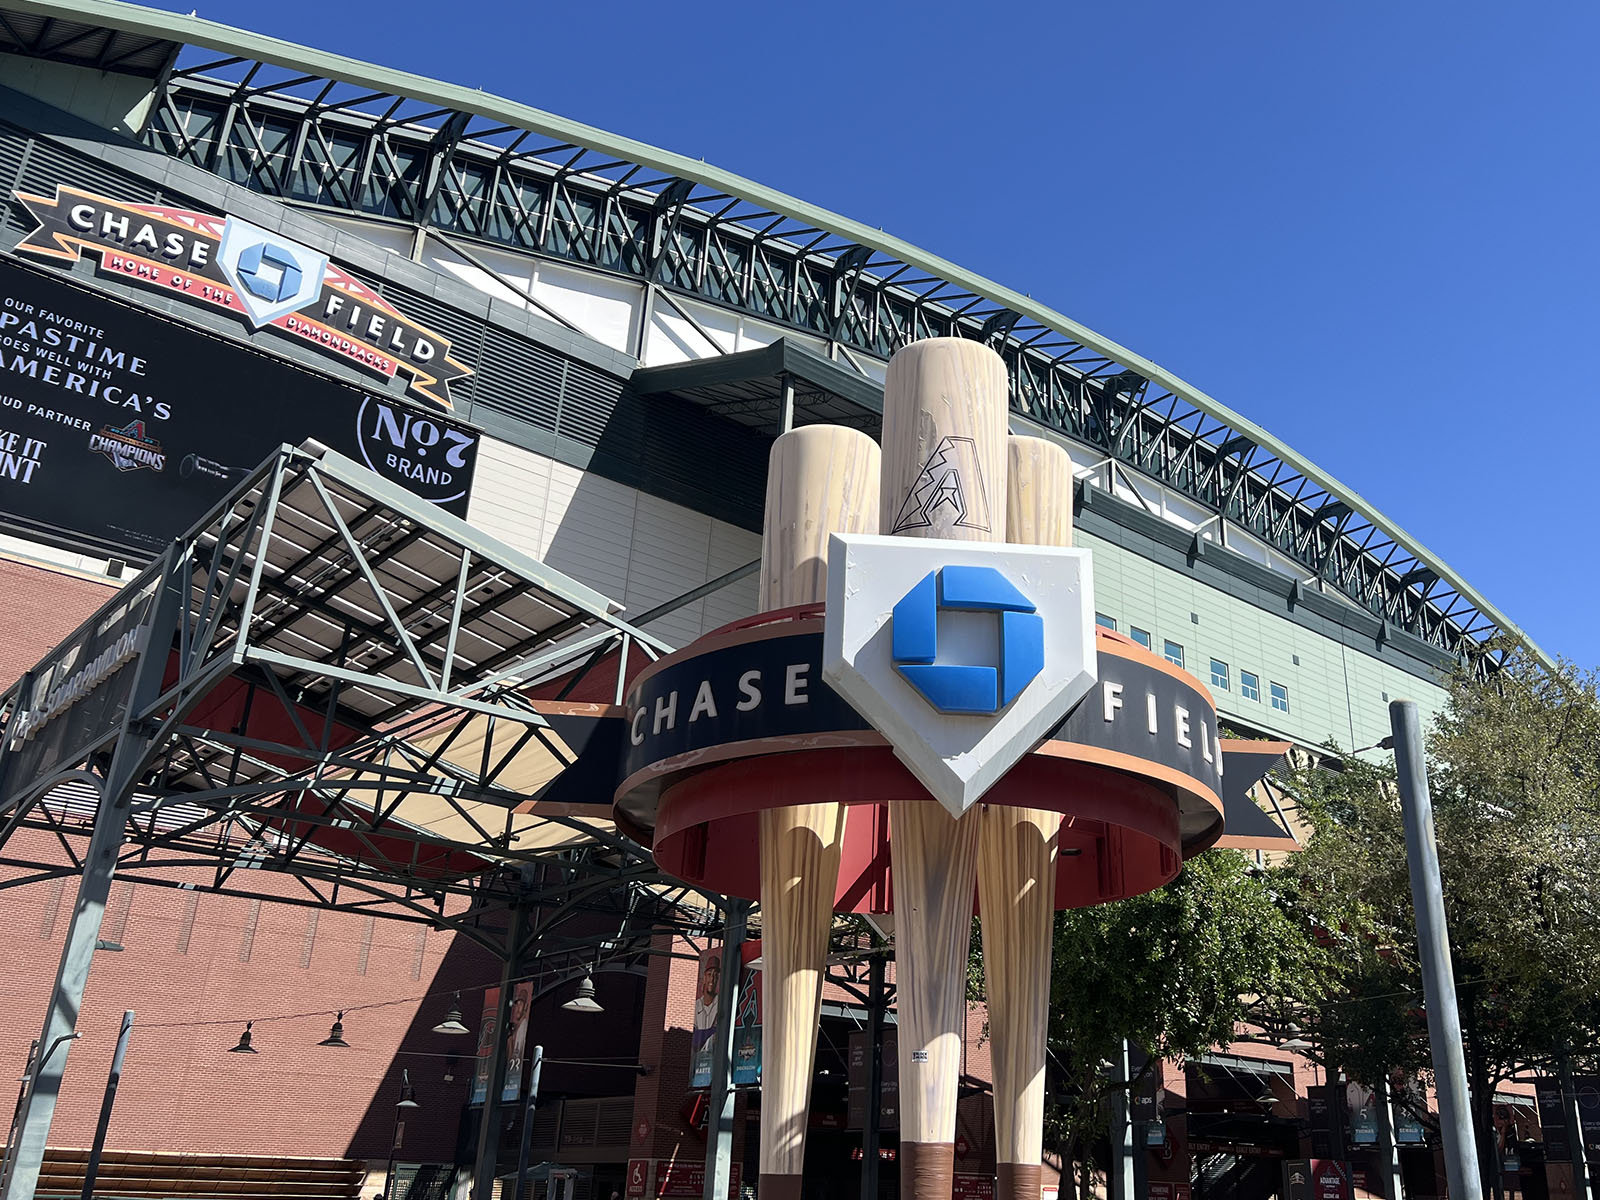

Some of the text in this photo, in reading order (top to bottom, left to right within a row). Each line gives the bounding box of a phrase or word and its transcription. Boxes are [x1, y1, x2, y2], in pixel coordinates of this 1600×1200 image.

[70, 204, 211, 265] CHASE
[113, 256, 233, 302] HOME OF THE
[4, 297, 105, 339] OUR FAVORITE
[325, 294, 435, 361] FIELD
[0, 311, 148, 376] PASTIME
[0, 334, 112, 380] OES WELL WITH
[287, 317, 390, 368] DIAMONDBACKS
[0, 351, 172, 421] MERICA'S
[0, 394, 92, 432] UD PARTNER
[22, 437, 48, 460] IT
[88, 434, 166, 471] CHAMPIONS
[386, 453, 453, 485] BRAND
[631, 663, 811, 747] CHASE
[1141, 1097, 1153, 1105] aps
[1360, 1108, 1367, 1120] 5
